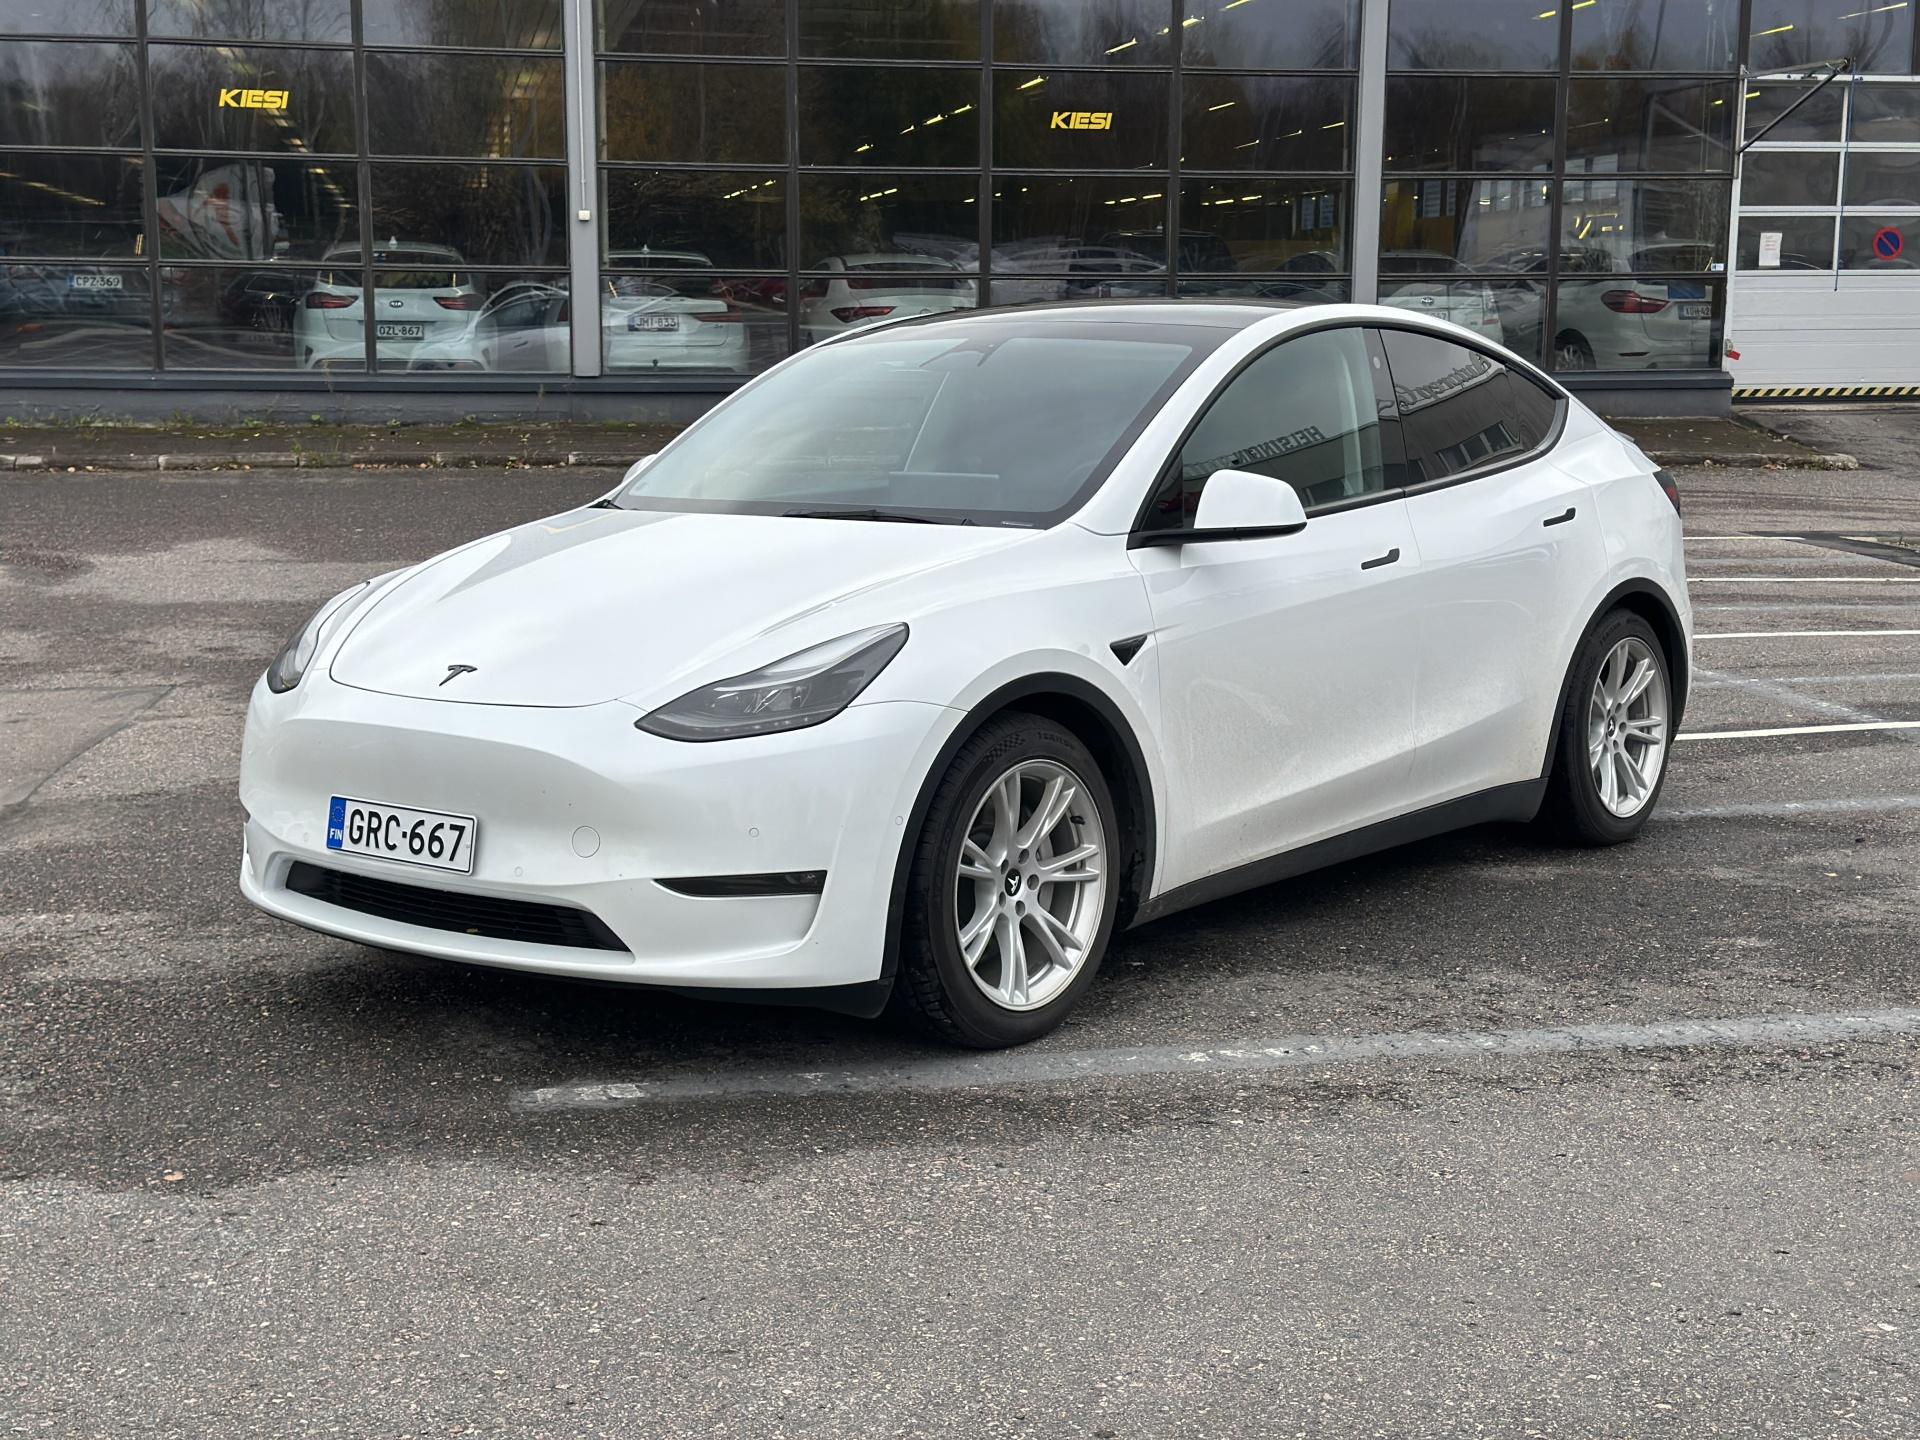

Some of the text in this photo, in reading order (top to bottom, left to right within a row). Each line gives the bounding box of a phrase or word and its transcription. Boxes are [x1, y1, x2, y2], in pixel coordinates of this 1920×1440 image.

[219, 88, 289, 109] KIESI
[1050, 111, 1113, 130] KIESI
[329, 808, 466, 862] FIN GRC-667
